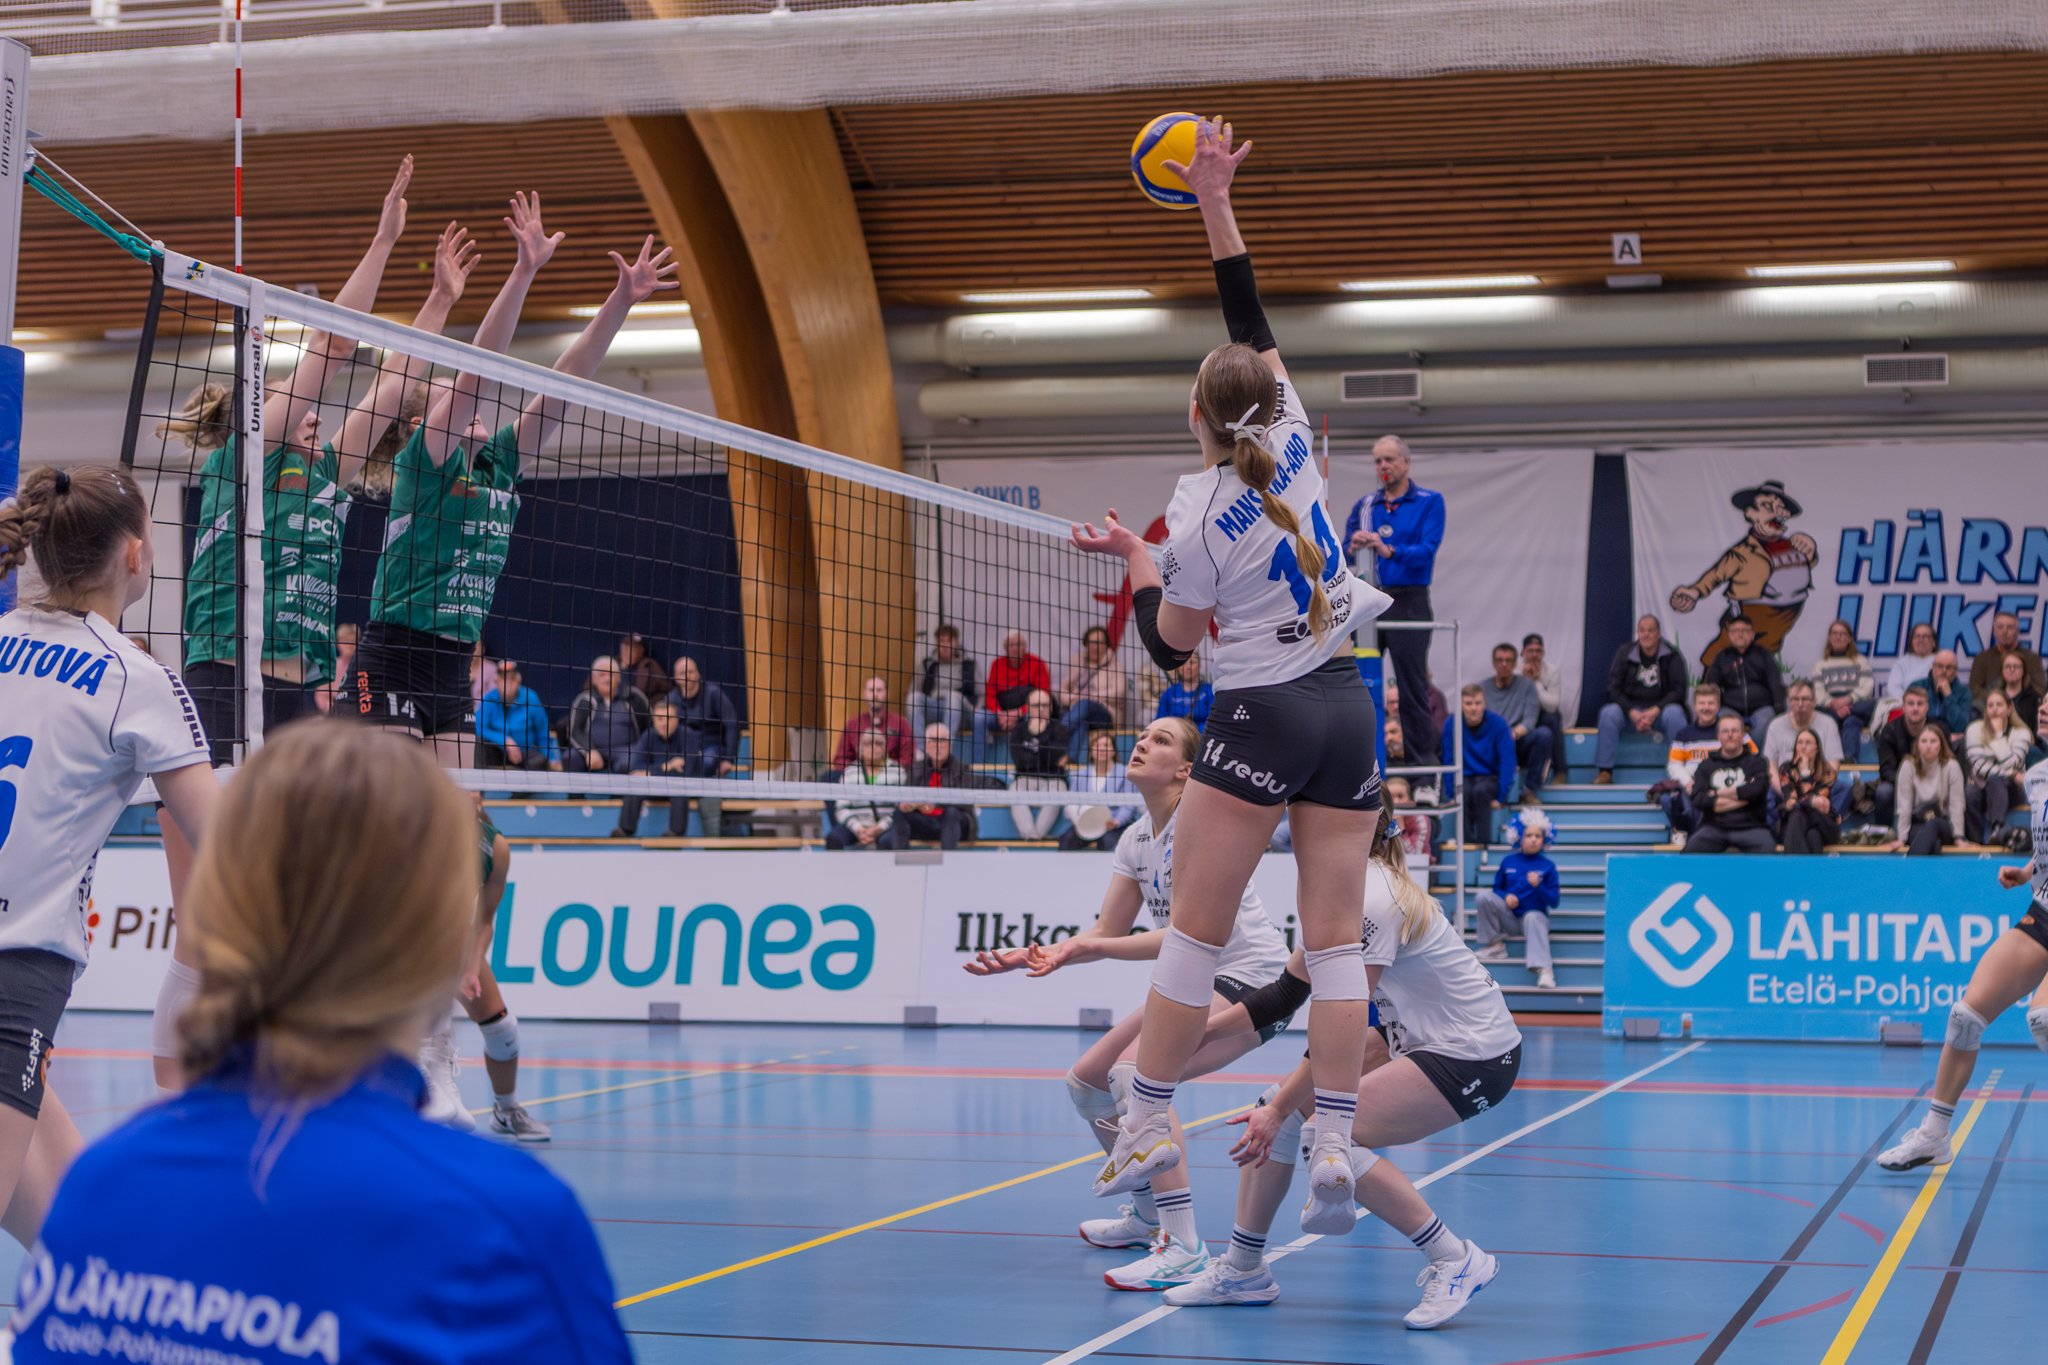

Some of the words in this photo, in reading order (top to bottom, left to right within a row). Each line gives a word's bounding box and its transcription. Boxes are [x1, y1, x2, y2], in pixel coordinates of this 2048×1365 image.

[1618, 239, 1637, 259] A
[251, 344, 260, 432] Universal
[1029, 486, 1041, 510] B
[1267, 500, 1340, 616] 14
[1836, 593, 2048, 657] LIIKE
[0, 632, 116, 697] ÚTOVÁ
[387, 692, 416, 719] 14
[1203, 738, 1225, 767] 14
[1223, 759, 1287, 795] sedu
[490, 882, 876, 992] Lounea
[26, 1028, 43, 1078] CRAFT
[55, 1255, 341, 1364] LÄHITAPIOLA
